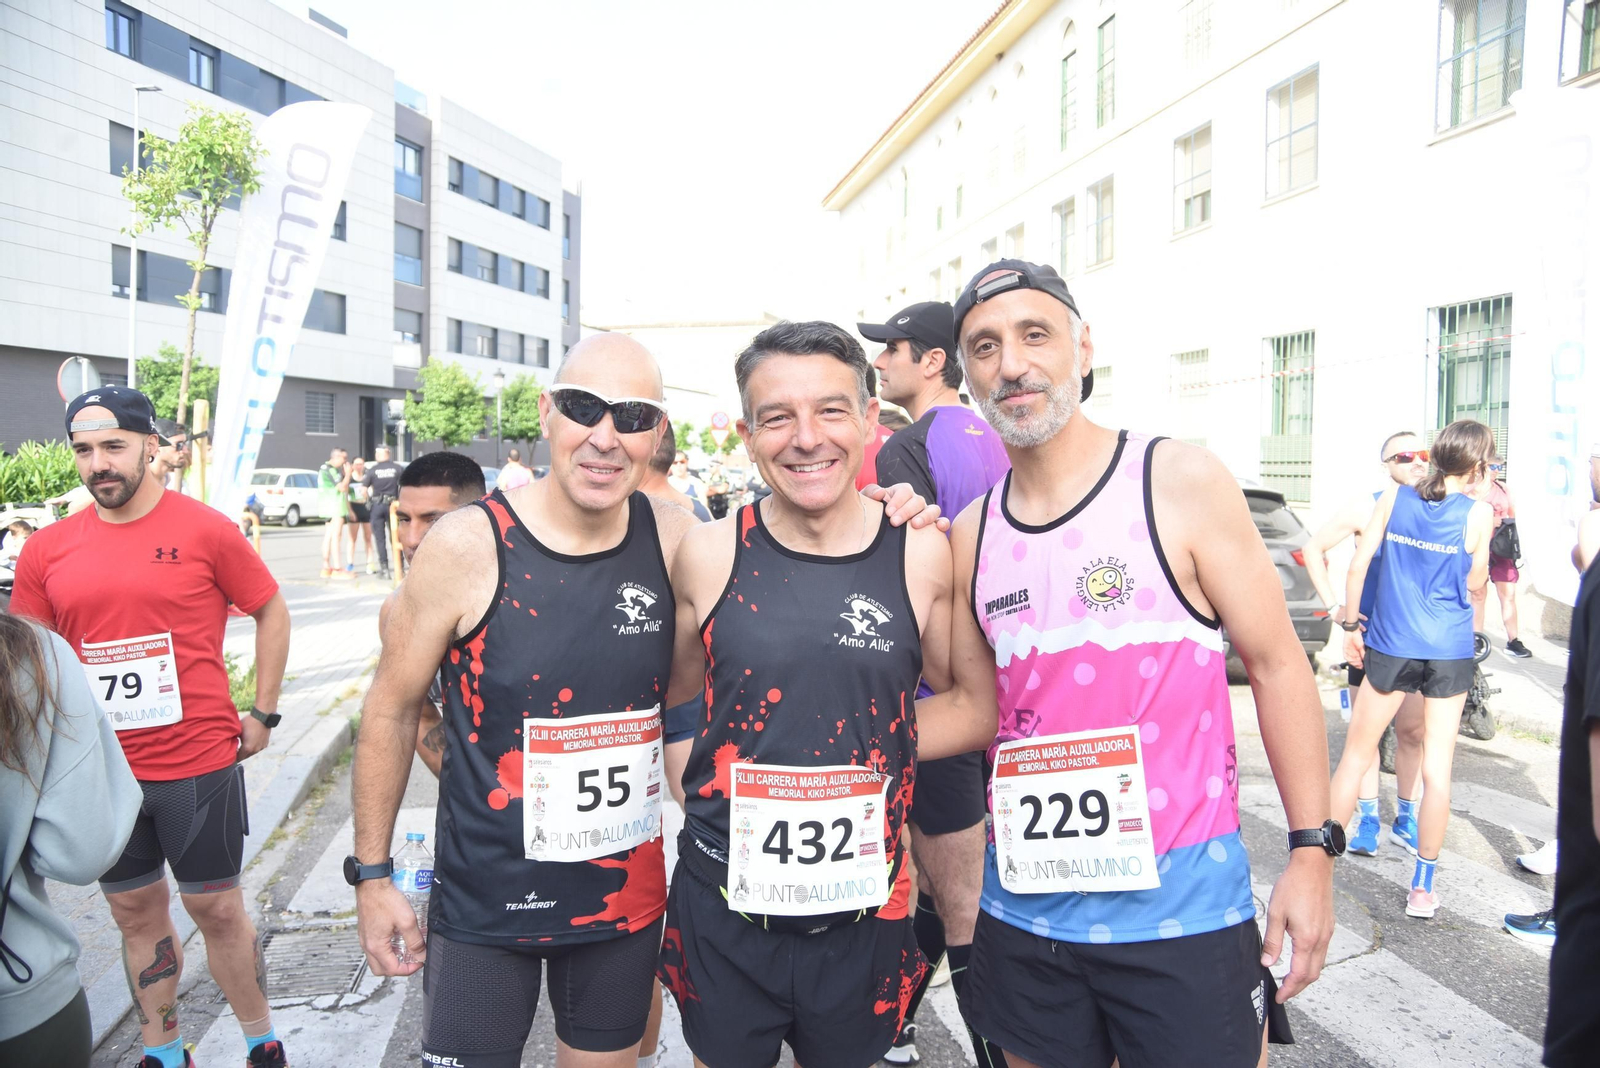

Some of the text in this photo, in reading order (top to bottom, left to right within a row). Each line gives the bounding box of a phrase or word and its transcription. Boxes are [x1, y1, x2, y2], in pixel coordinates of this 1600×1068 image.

[1386, 531, 1459, 554] HORNACHUELOS
[1082, 566, 1090, 574] A
[1090, 557, 1104, 568] LA
[616, 582, 627, 594] CLUB
[1076, 576, 1099, 612] LENGUA
[1117, 578, 1135, 605] SACA
[844, 593, 858, 604] CLUB
[859, 593, 867, 601] DE
[985, 588, 1029, 616] IMPARABLES
[1102, 602, 1116, 612] LA
[106, 646, 127, 656] MARÍA
[98, 672, 142, 701] 79
[530, 728, 548, 740] XLIII
[550, 726, 589, 740] CARRERA
[590, 722, 617, 736] MARÍA
[563, 740, 597, 751] MEMORIAL
[597, 737, 614, 747] KIKO
[1010, 750, 1042, 762] CARRERA
[1042, 743, 1068, 759] MARÍA
[1069, 738, 1133, 756] AUXILIADORA.
[1017, 756, 1100, 773] MEMORIAL KIKO PASTOR.
[737, 771, 755, 783] XLIII
[756, 773, 797, 787] CARRERA
[799, 774, 828, 788] MARÍA
[577, 765, 631, 812] 55
[768, 785, 852, 798] MEMORIAL KIKO PASTOR.
[1019, 789, 1110, 841] 229
[762, 817, 854, 865] 432
[505, 900, 557, 911] TEAMERGY
